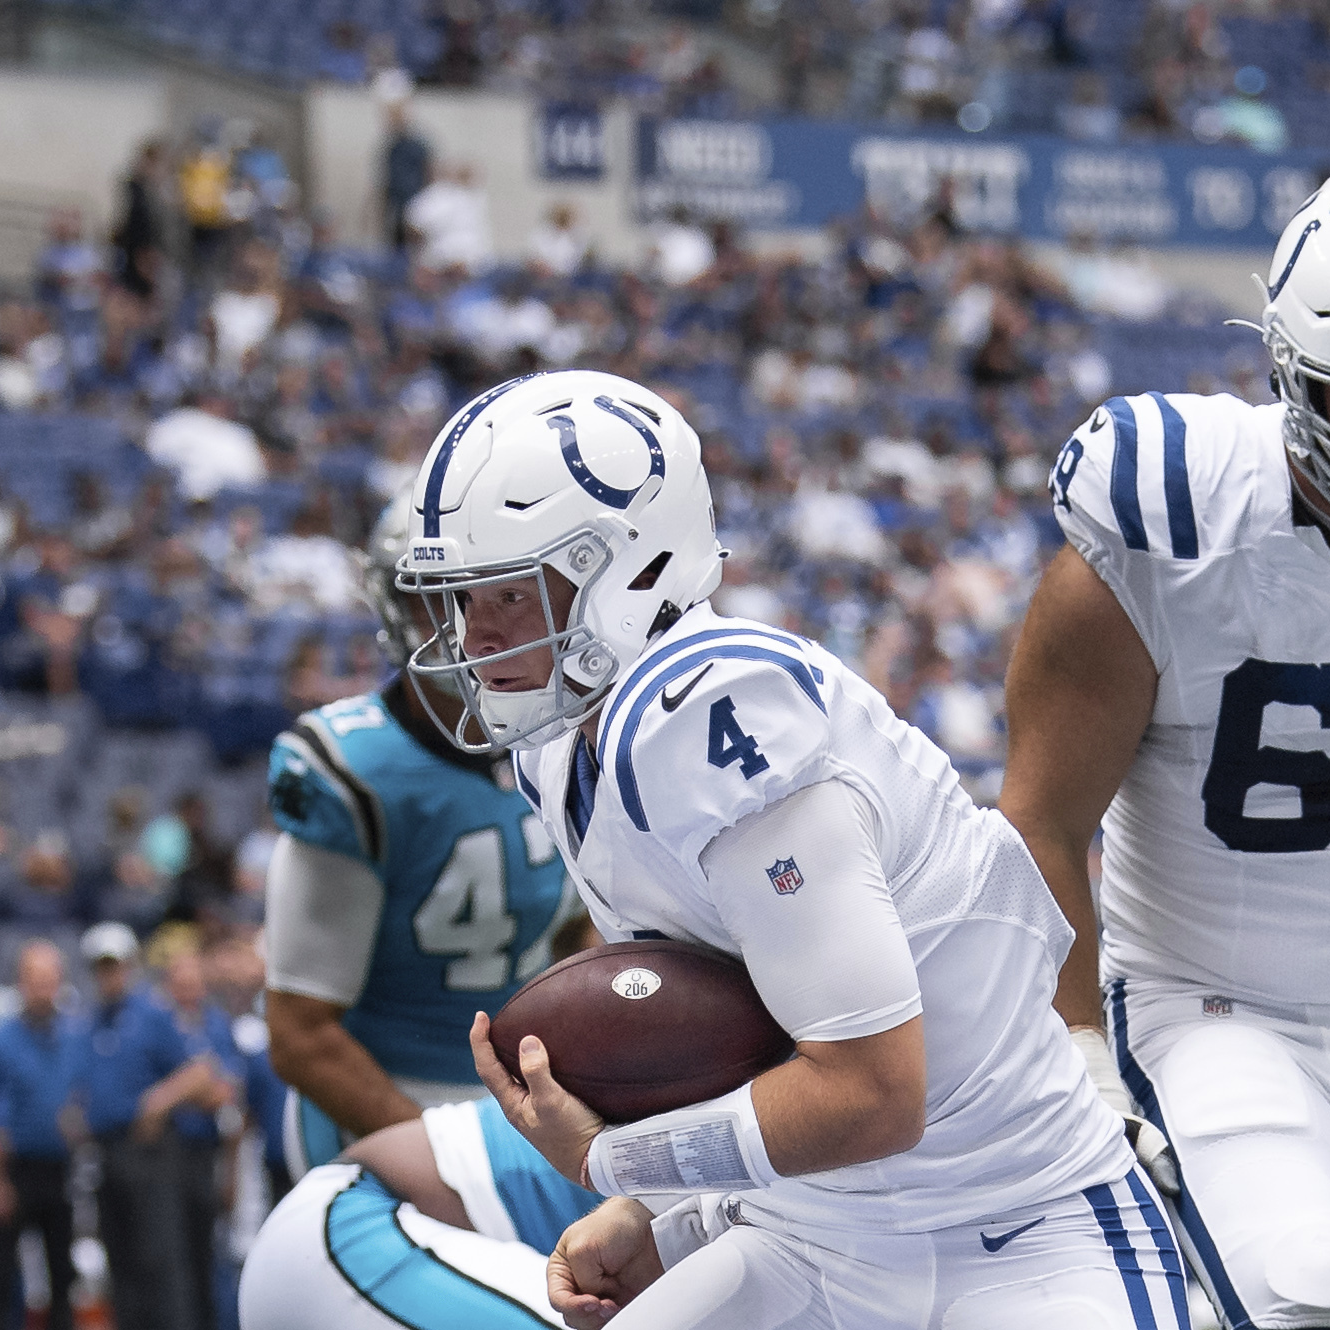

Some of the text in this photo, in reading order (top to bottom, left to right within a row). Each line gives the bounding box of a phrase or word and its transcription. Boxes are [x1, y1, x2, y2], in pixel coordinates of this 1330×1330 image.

[413, 546, 445, 561] COLTS
[707, 694, 770, 781] 4
[624, 982, 648, 997] 206
